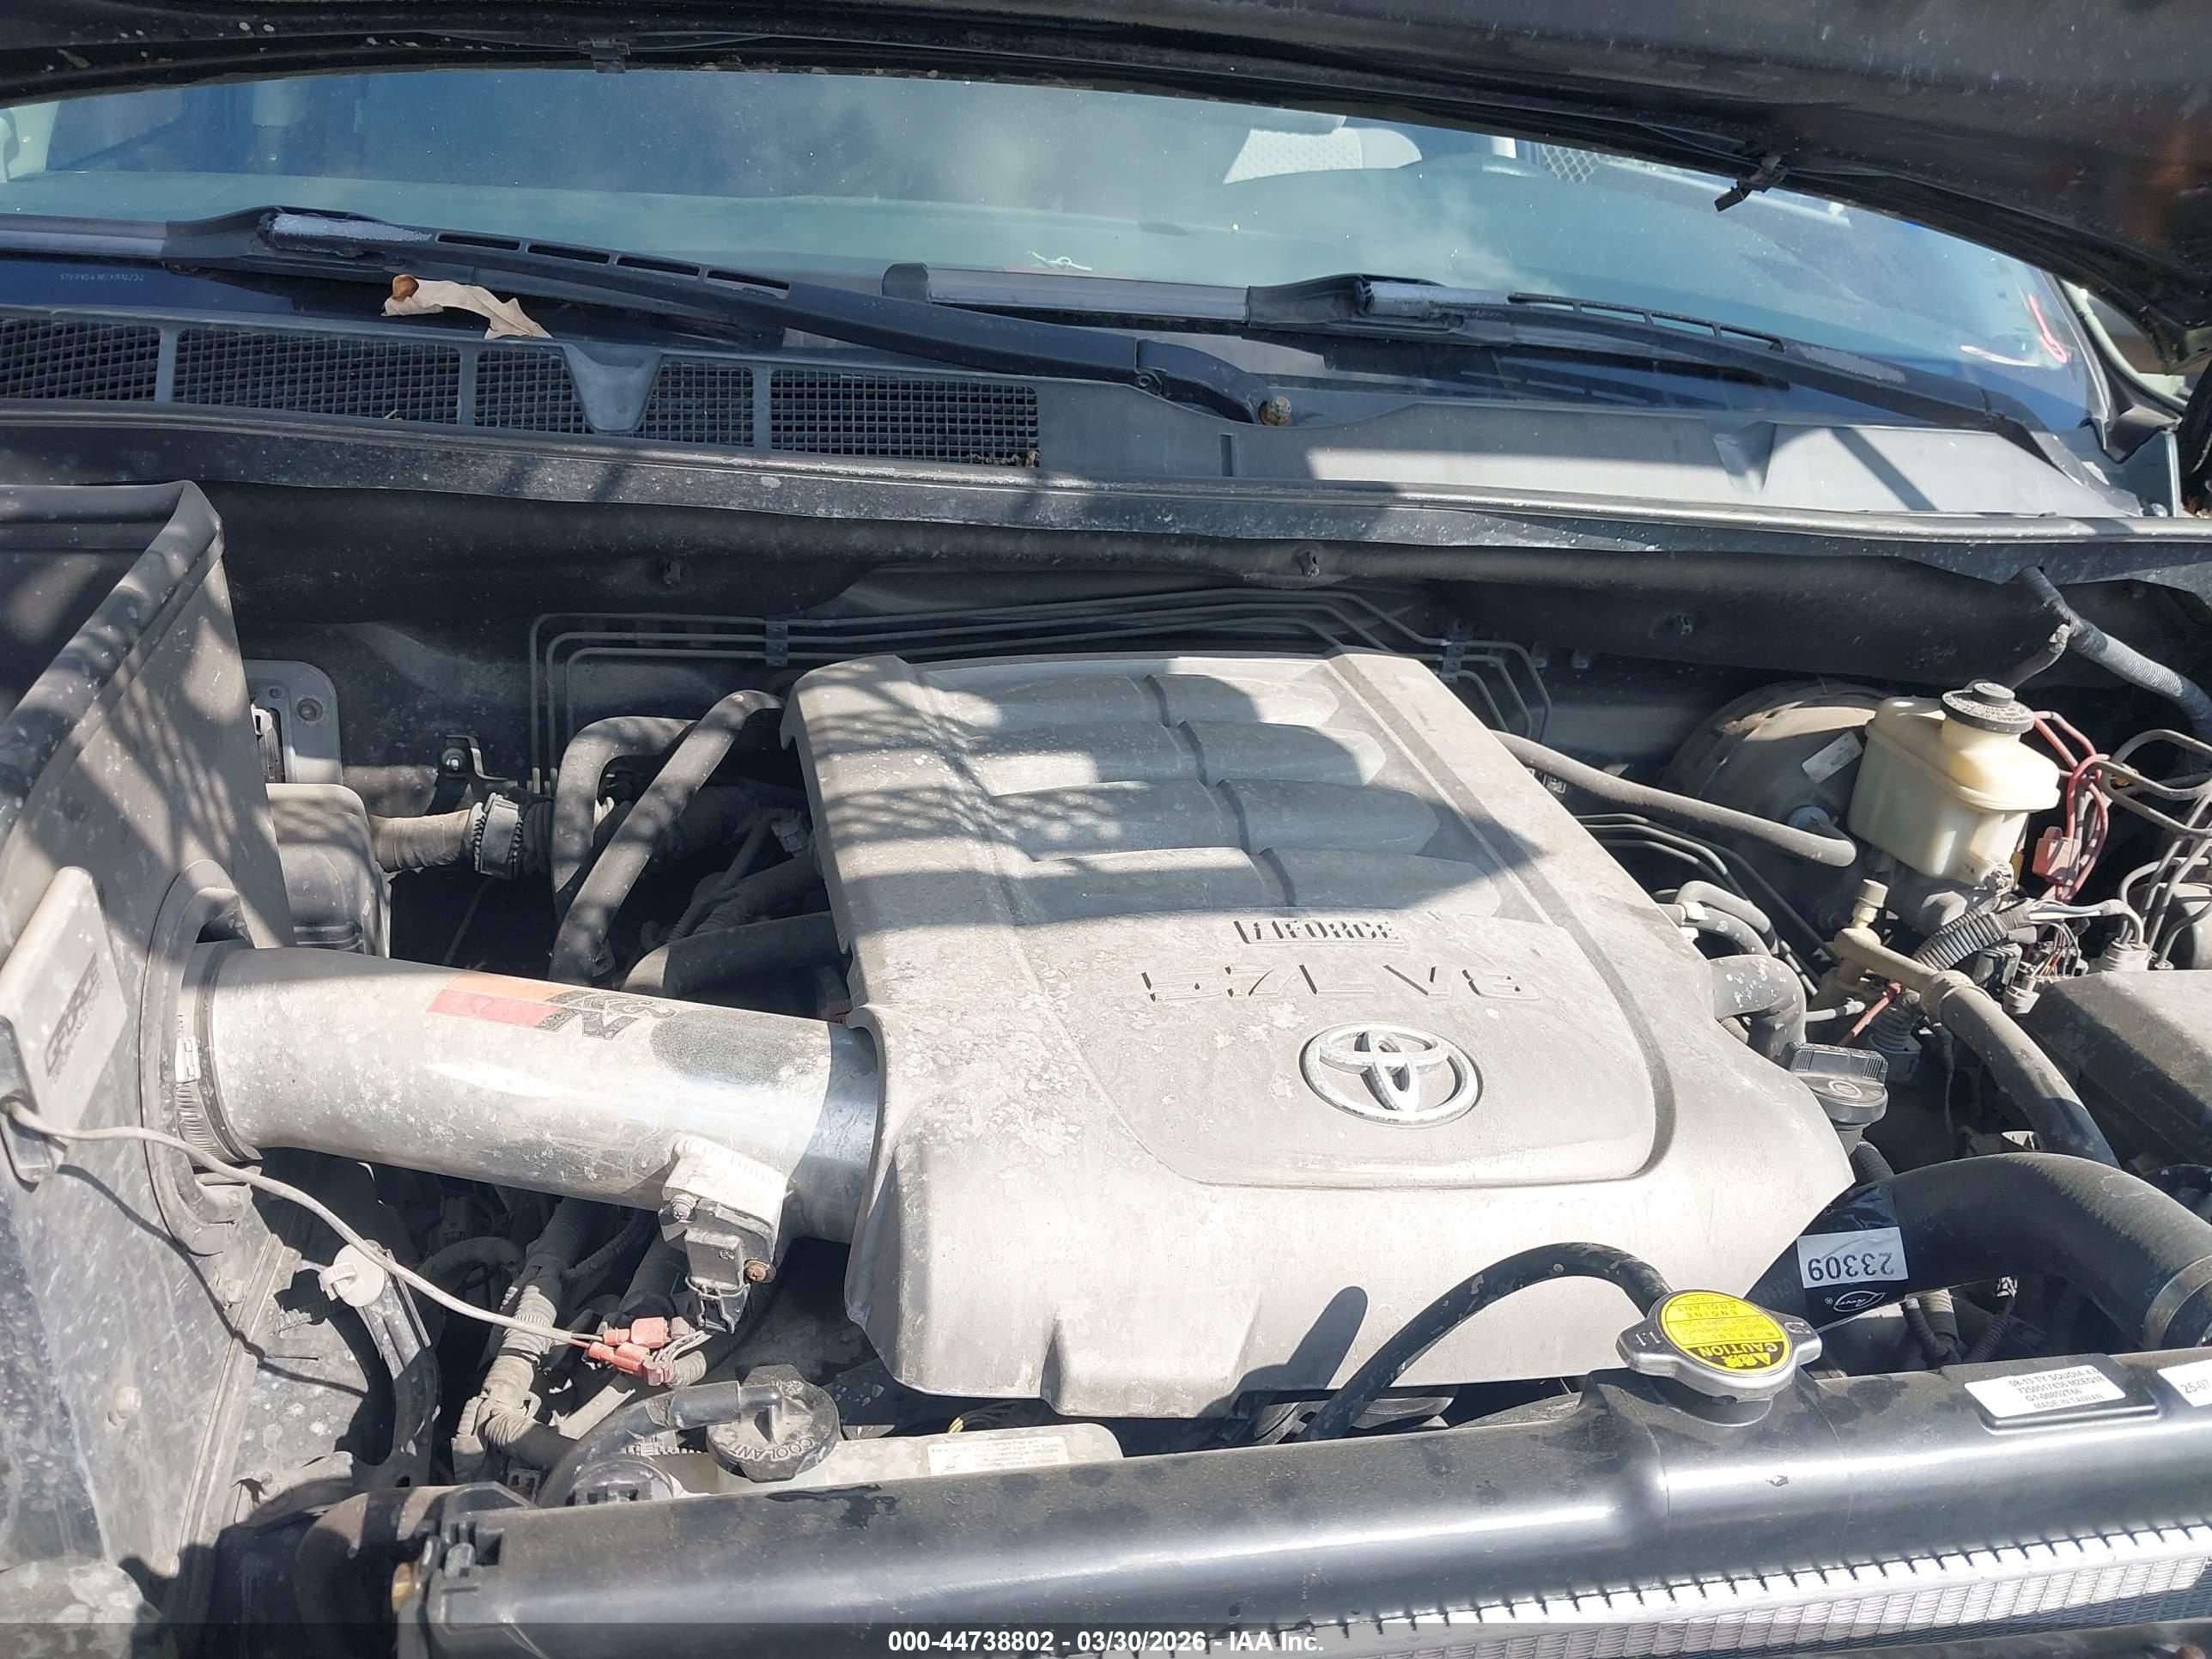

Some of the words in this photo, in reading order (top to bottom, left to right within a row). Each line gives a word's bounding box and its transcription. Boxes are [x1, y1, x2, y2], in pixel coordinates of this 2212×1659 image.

[1807, 1251, 1895, 1281] 23309
[1686, 1310, 1739, 1319] ENGINE
[1697, 1341, 1778, 1358] CAUTION
[2033, 1399, 2058, 1409] MADE
[2061, 1398, 2069, 1407] IN
[2071, 1394, 2105, 1405] TAIWAN
[729, 1437, 813, 1462] COOLANT
